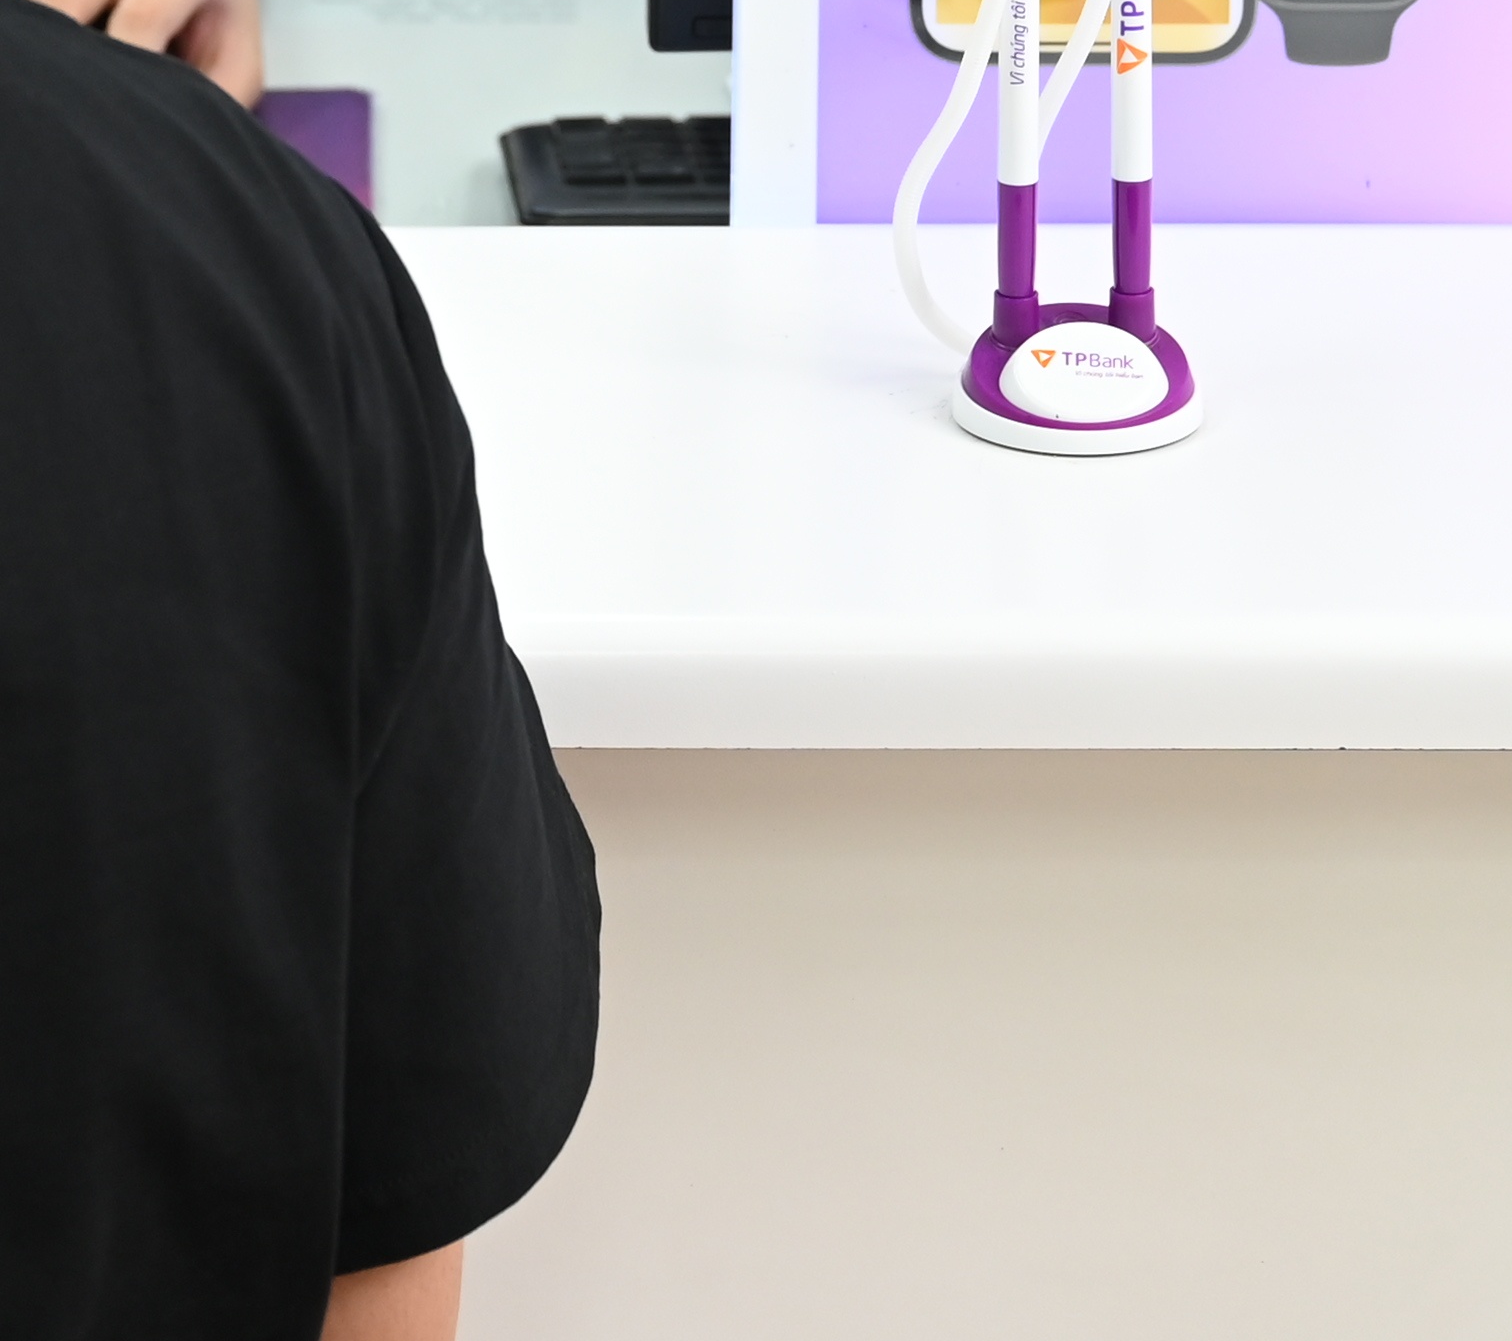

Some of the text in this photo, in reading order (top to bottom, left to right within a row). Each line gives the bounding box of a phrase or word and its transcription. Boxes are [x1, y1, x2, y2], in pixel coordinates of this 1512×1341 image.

[1010, 0, 1027, 20] tôi
[1009, 23, 1029, 69] chúng
[1062, 351, 1134, 370] TPBank
